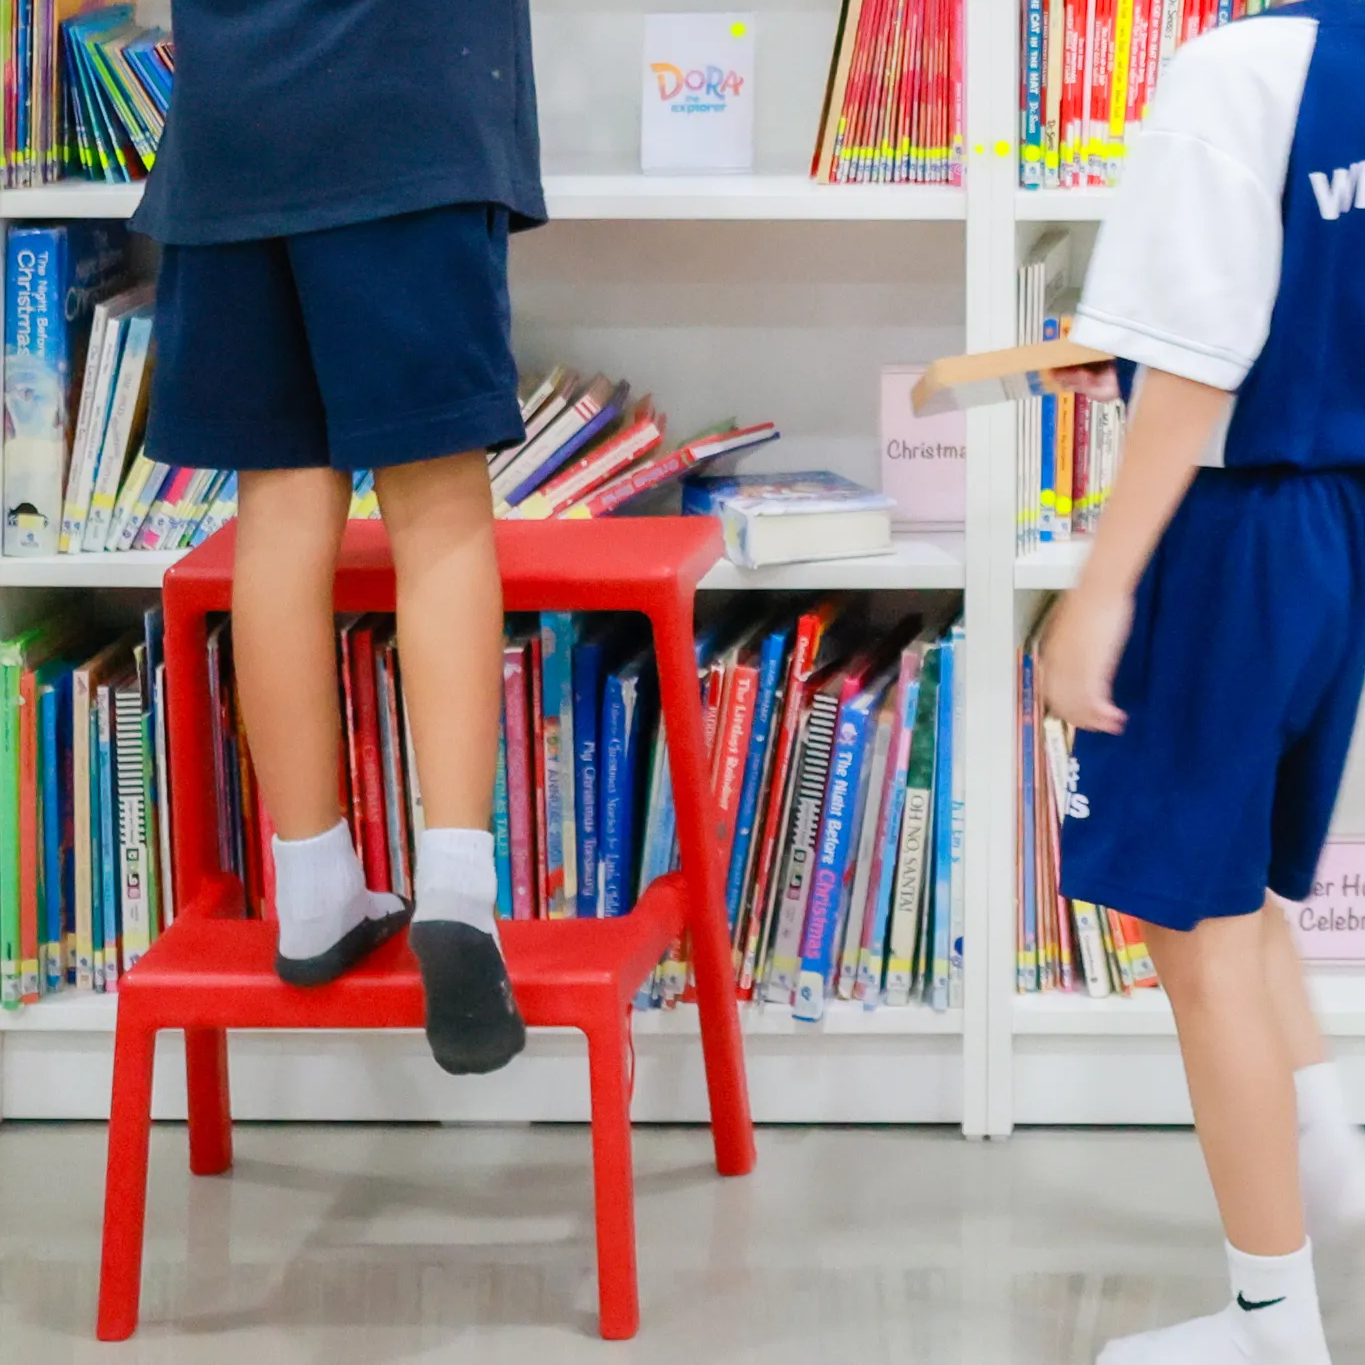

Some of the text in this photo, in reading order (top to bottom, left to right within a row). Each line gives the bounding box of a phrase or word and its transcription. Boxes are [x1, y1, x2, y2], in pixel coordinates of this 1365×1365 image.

[1028, 13, 1039, 34] CAT
[1028, 51, 1039, 69] THE
[1028, 72, 1039, 95] HAT
[15, 249, 36, 356] Christmas
[34, 251, 48, 358] The Night Before
[887, 438, 966, 461] Christma
[735, 678, 751, 700] The
[729, 701, 748, 751] Littlest
[579, 740, 598, 897] My Christmas Treasury
[911, 794, 924, 820] OH
[804, 751, 853, 959] The Night Before Christmas
